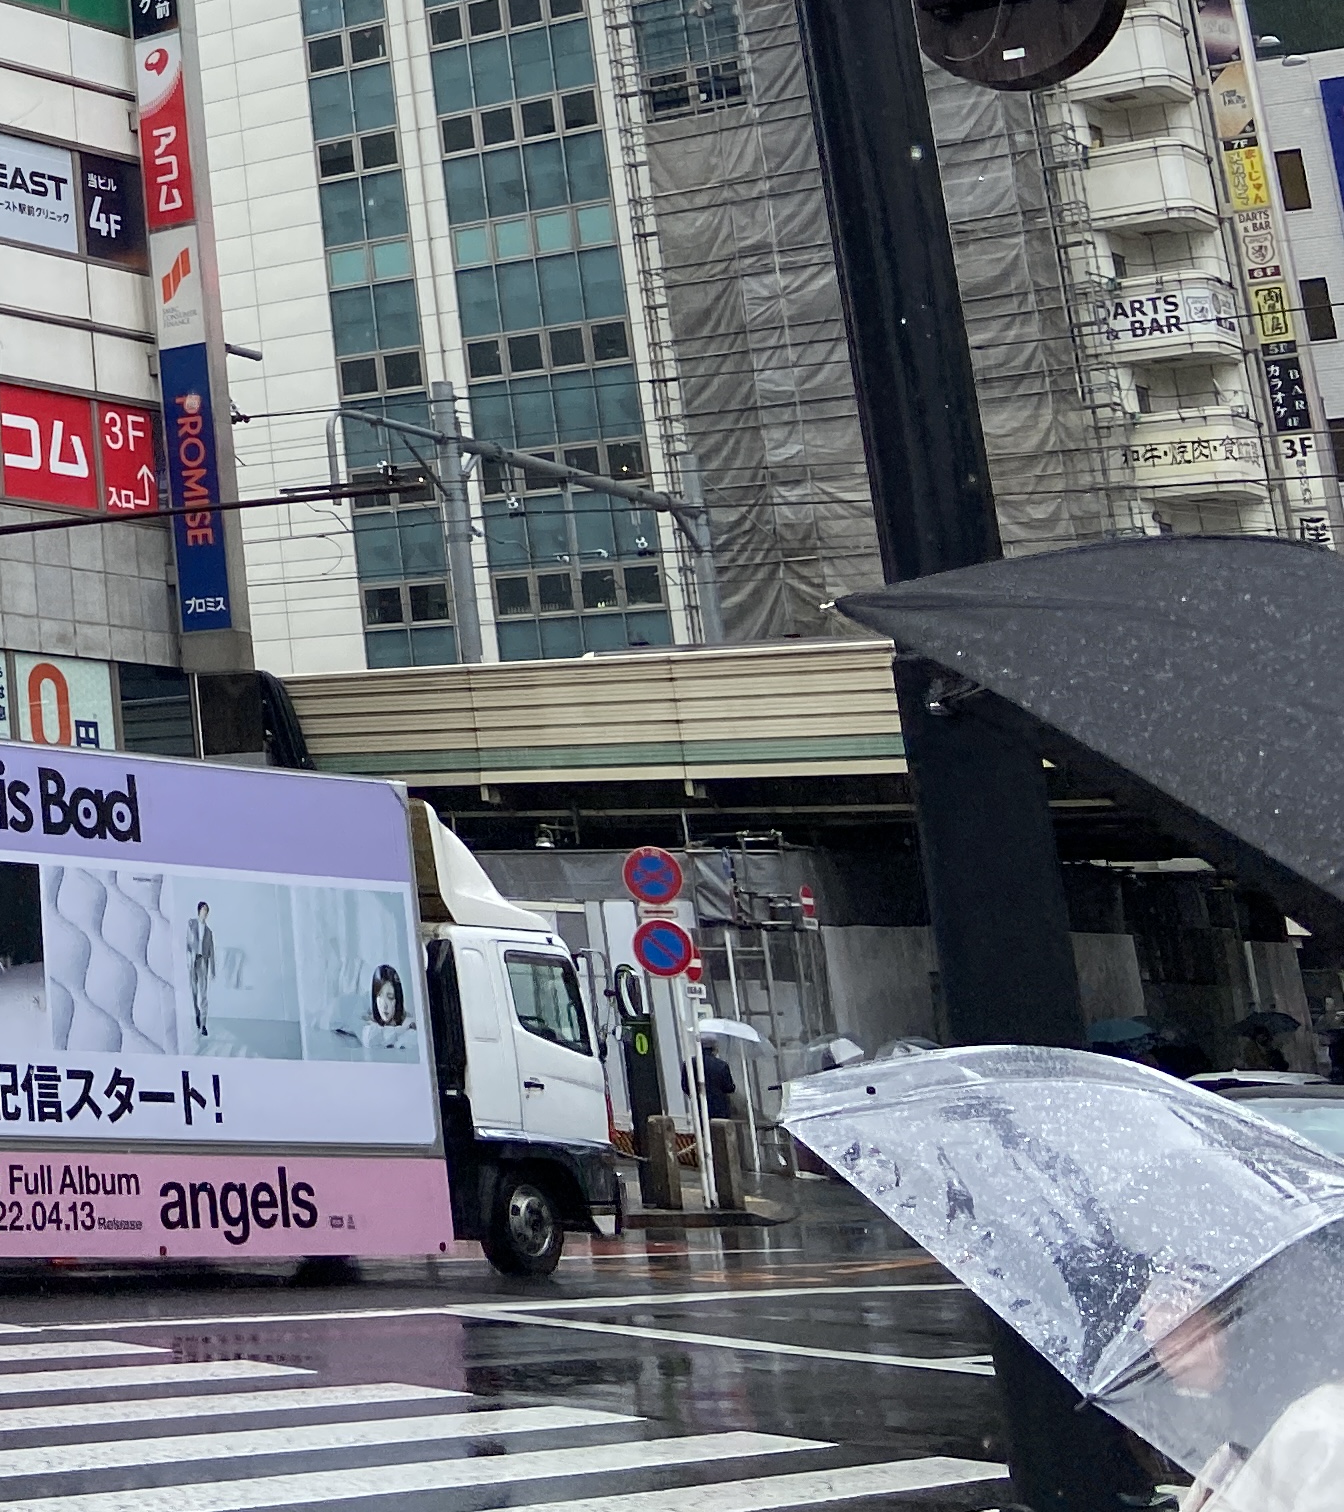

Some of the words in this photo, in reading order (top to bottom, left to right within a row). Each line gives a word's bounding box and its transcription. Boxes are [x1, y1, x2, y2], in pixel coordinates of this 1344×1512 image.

[87, 172, 117, 192] 当ビル
[152, 126, 184, 213] アコム
[89, 196, 122, 238] 4F
[1238, 210, 1270, 224] DARTS
[1252, 221, 1273, 232] BAR
[1130, 315, 1184, 338] BAR
[1266, 363, 1288, 419] カラオケ
[1287, 368, 1307, 411] BAR
[104, 411, 146, 452] 3F
[1281, 436, 1314, 458] 3F
[174, 392, 214, 549] PROMISE
[108, 486, 136, 509] 入口
[185, 596, 227, 615] プロミス
[40, 766, 143, 844] Bad
[9, 1164, 53, 1195] Full
[59, 1164, 142, 1196] Album
[159, 1165, 319, 1246] angels
